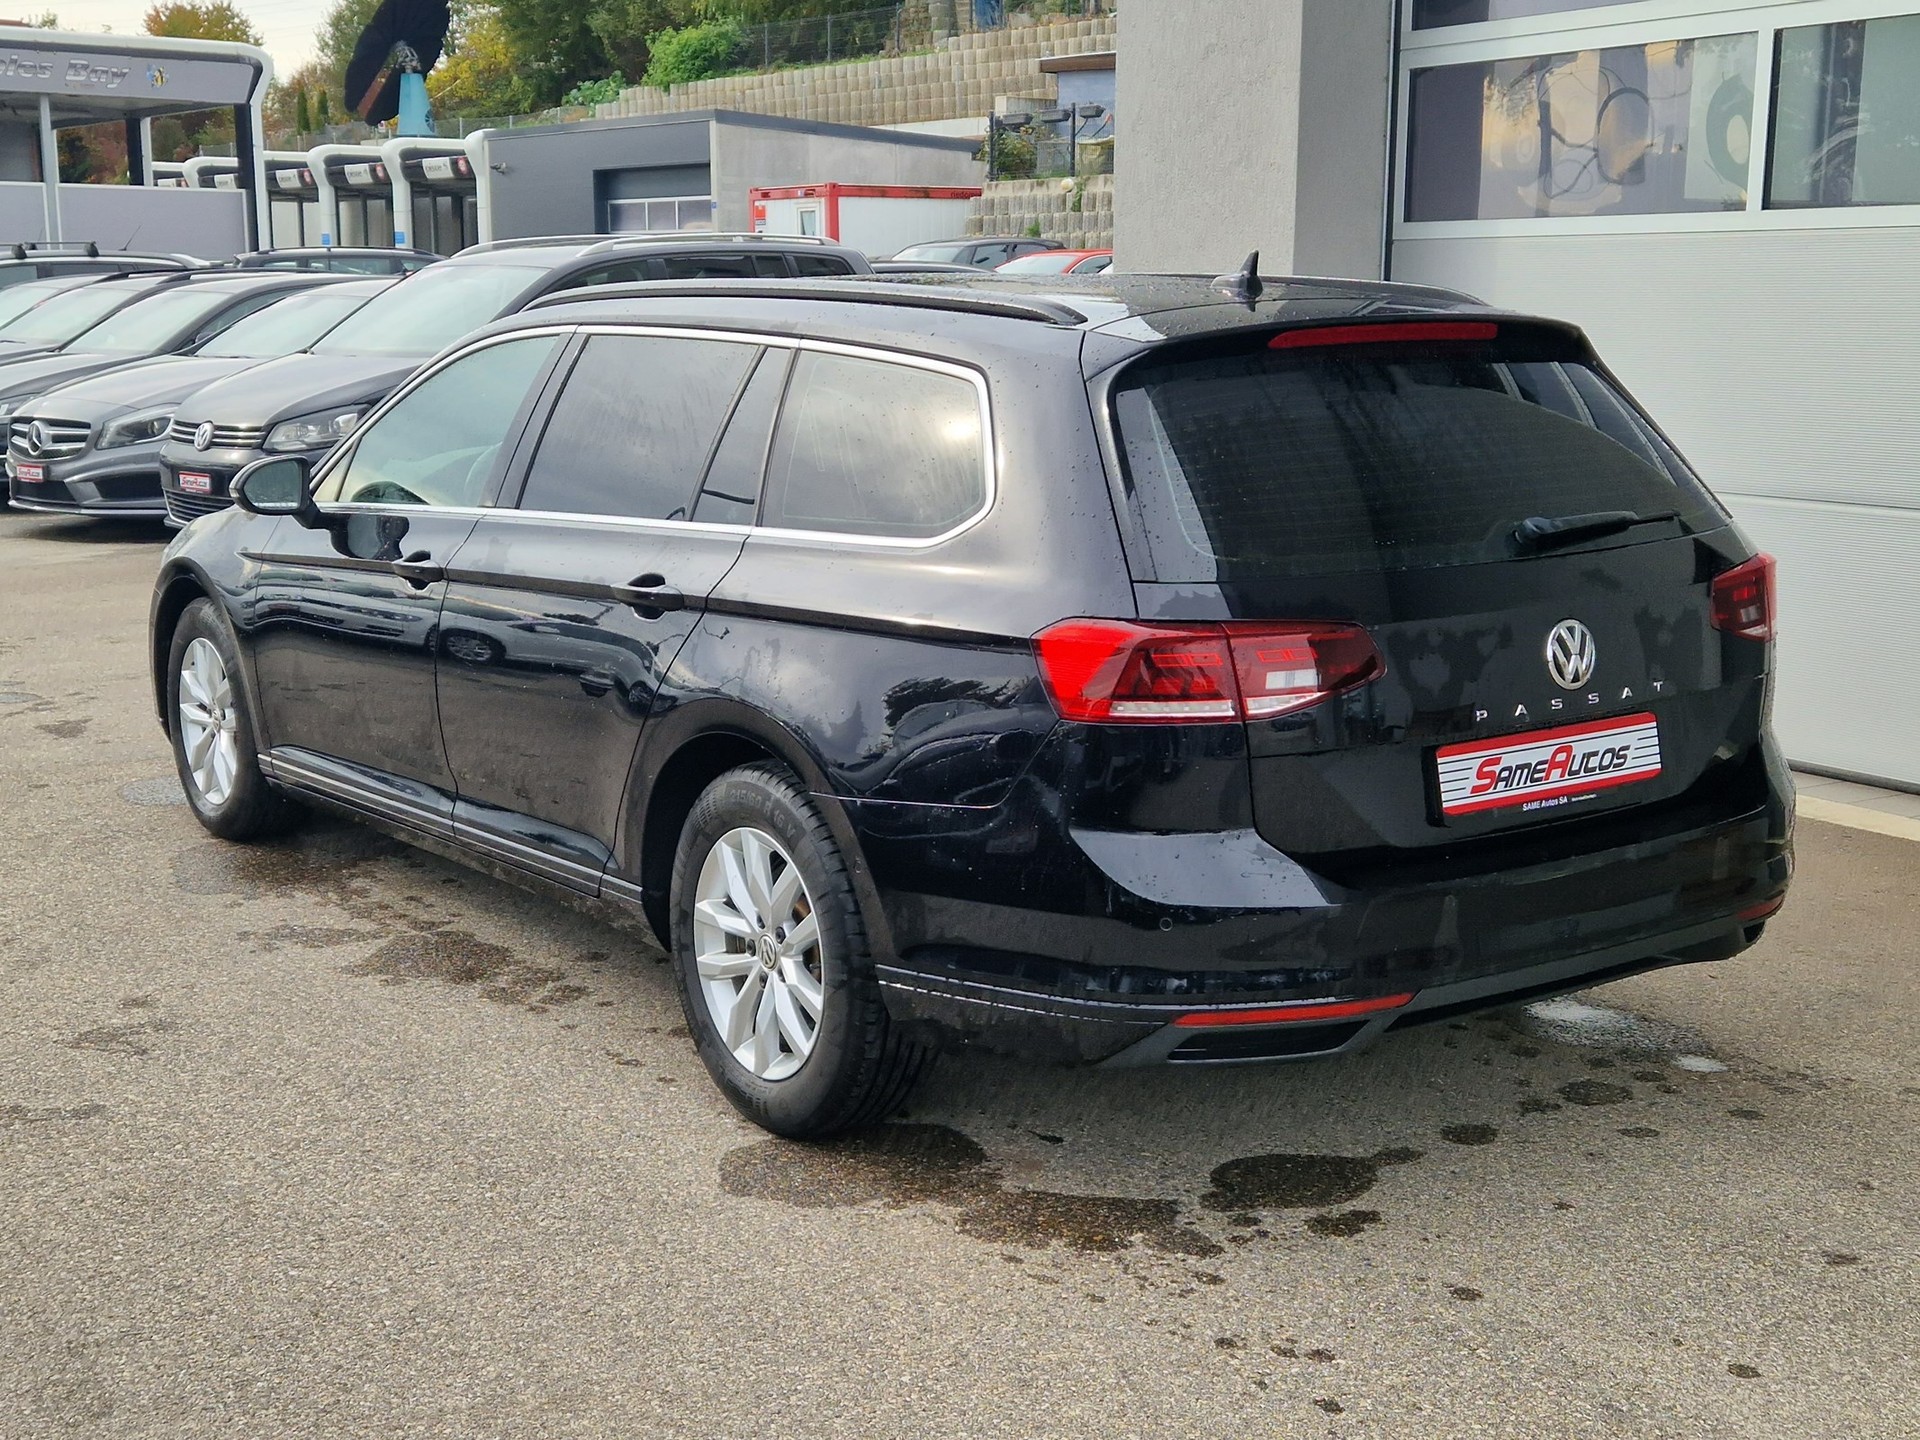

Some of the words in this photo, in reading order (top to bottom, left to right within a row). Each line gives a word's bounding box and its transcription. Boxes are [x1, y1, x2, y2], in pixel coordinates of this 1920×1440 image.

[65, 59, 131, 88] Bay
[1476, 680, 1664, 722] PASSAT
[1522, 801, 1540, 812] SAME
[1541, 798, 1558, 808] Autos
[1559, 795, 1568, 804] SA
